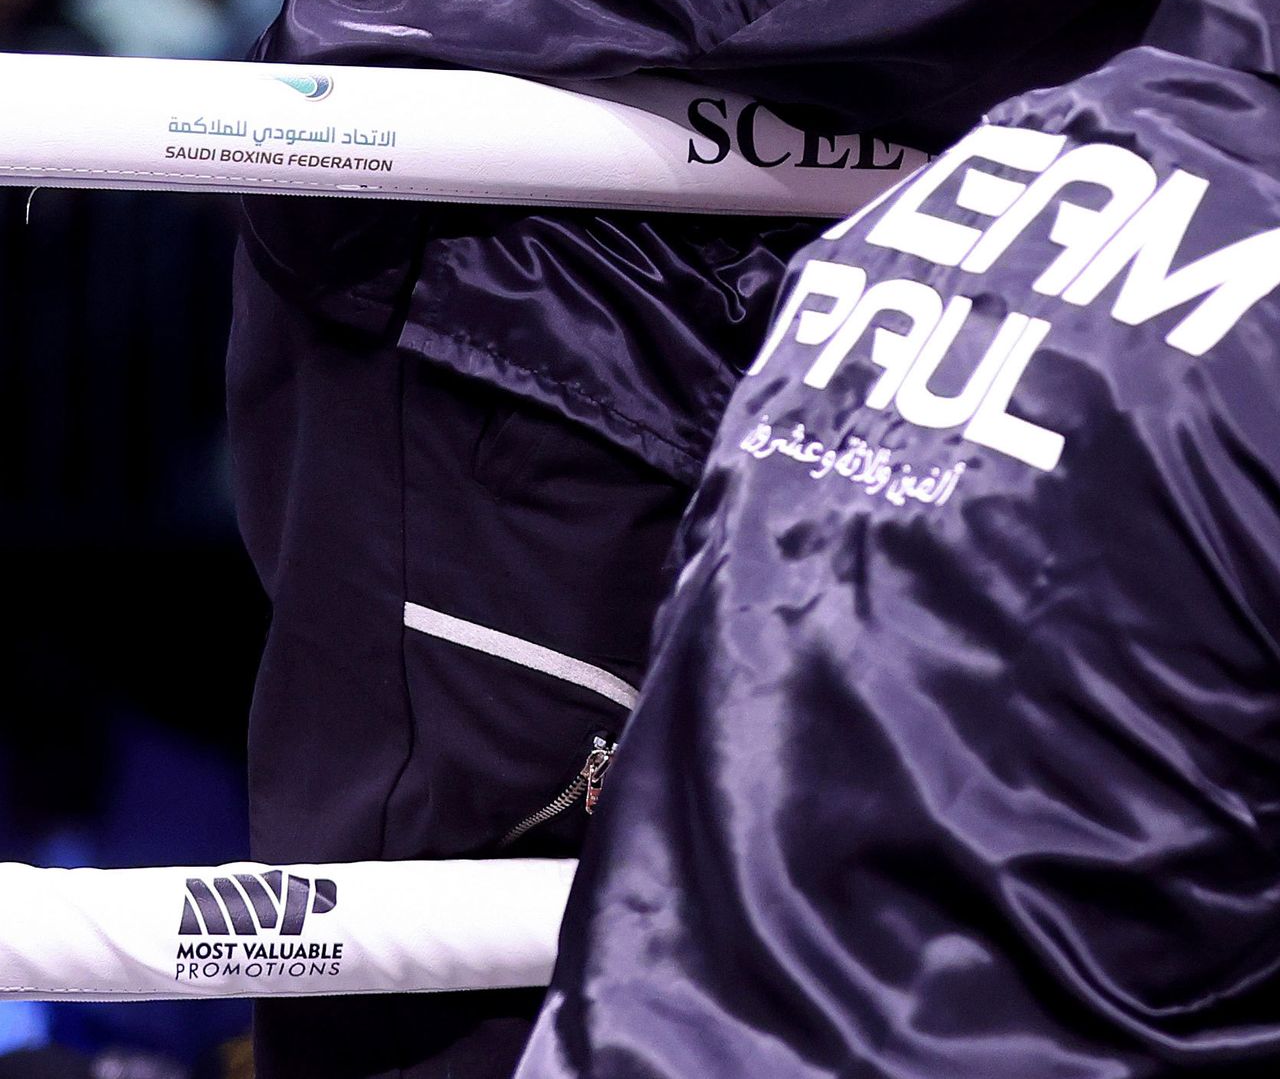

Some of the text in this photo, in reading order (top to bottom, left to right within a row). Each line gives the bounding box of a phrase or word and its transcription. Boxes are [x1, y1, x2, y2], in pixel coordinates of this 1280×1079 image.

[164, 146, 394, 172] SAUDI BOXING FEDERATION
[748, 259, 1066, 472] PAUL
[177, 869, 338, 936] MVP
[176, 942, 344, 960] MOST VALUABLE
[175, 961, 341, 981] PROMOTIONS
